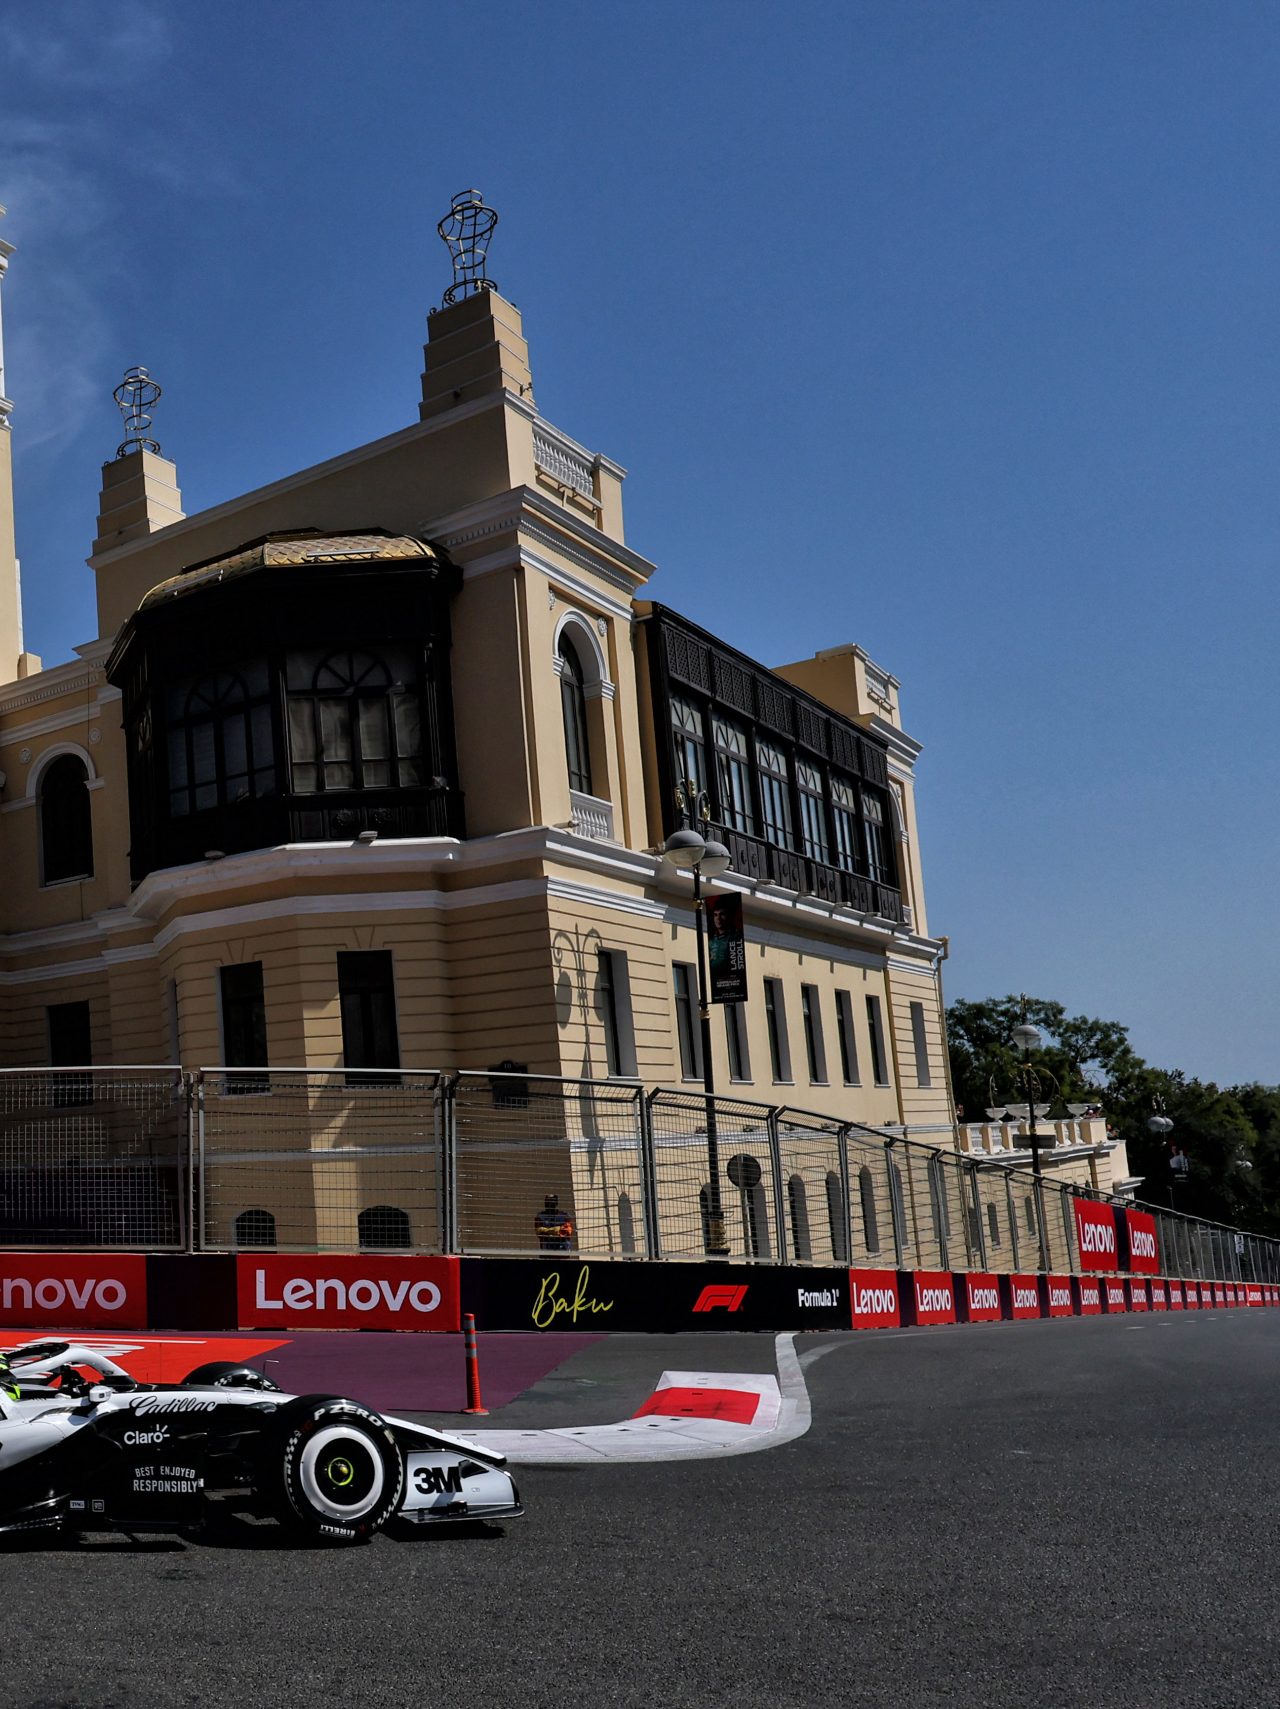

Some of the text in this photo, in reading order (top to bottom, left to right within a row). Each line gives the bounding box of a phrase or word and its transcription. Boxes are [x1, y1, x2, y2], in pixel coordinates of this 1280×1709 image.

[737, 938, 745, 970] STROLL
[1078, 1213, 1115, 1253] Lenovo
[1128, 1222, 1155, 1258] Lenovo
[255, 1269, 441, 1312] Lenovo
[531, 1265, 614, 1328] Baku
[797, 1288, 832, 1307] Formula
[853, 1282, 895, 1314] Lenovo
[916, 1283, 951, 1311] Lenovo
[969, 1284, 998, 1309] Lenovo
[1012, 1284, 1038, 1308] Lenovo
[1049, 1285, 1071, 1306] Lenovo
[1080, 1285, 1099, 1305] Lenovo
[129, 1395, 219, 1417] Cadillac
[314, 1404, 383, 1427] P ZERO
[123, 1430, 165, 1445] Claro
[134, 1465, 196, 1479] BEST ENJOYED
[413, 1465, 464, 1495] 3M
[133, 1479, 199, 1493] RESPONSIBLY
